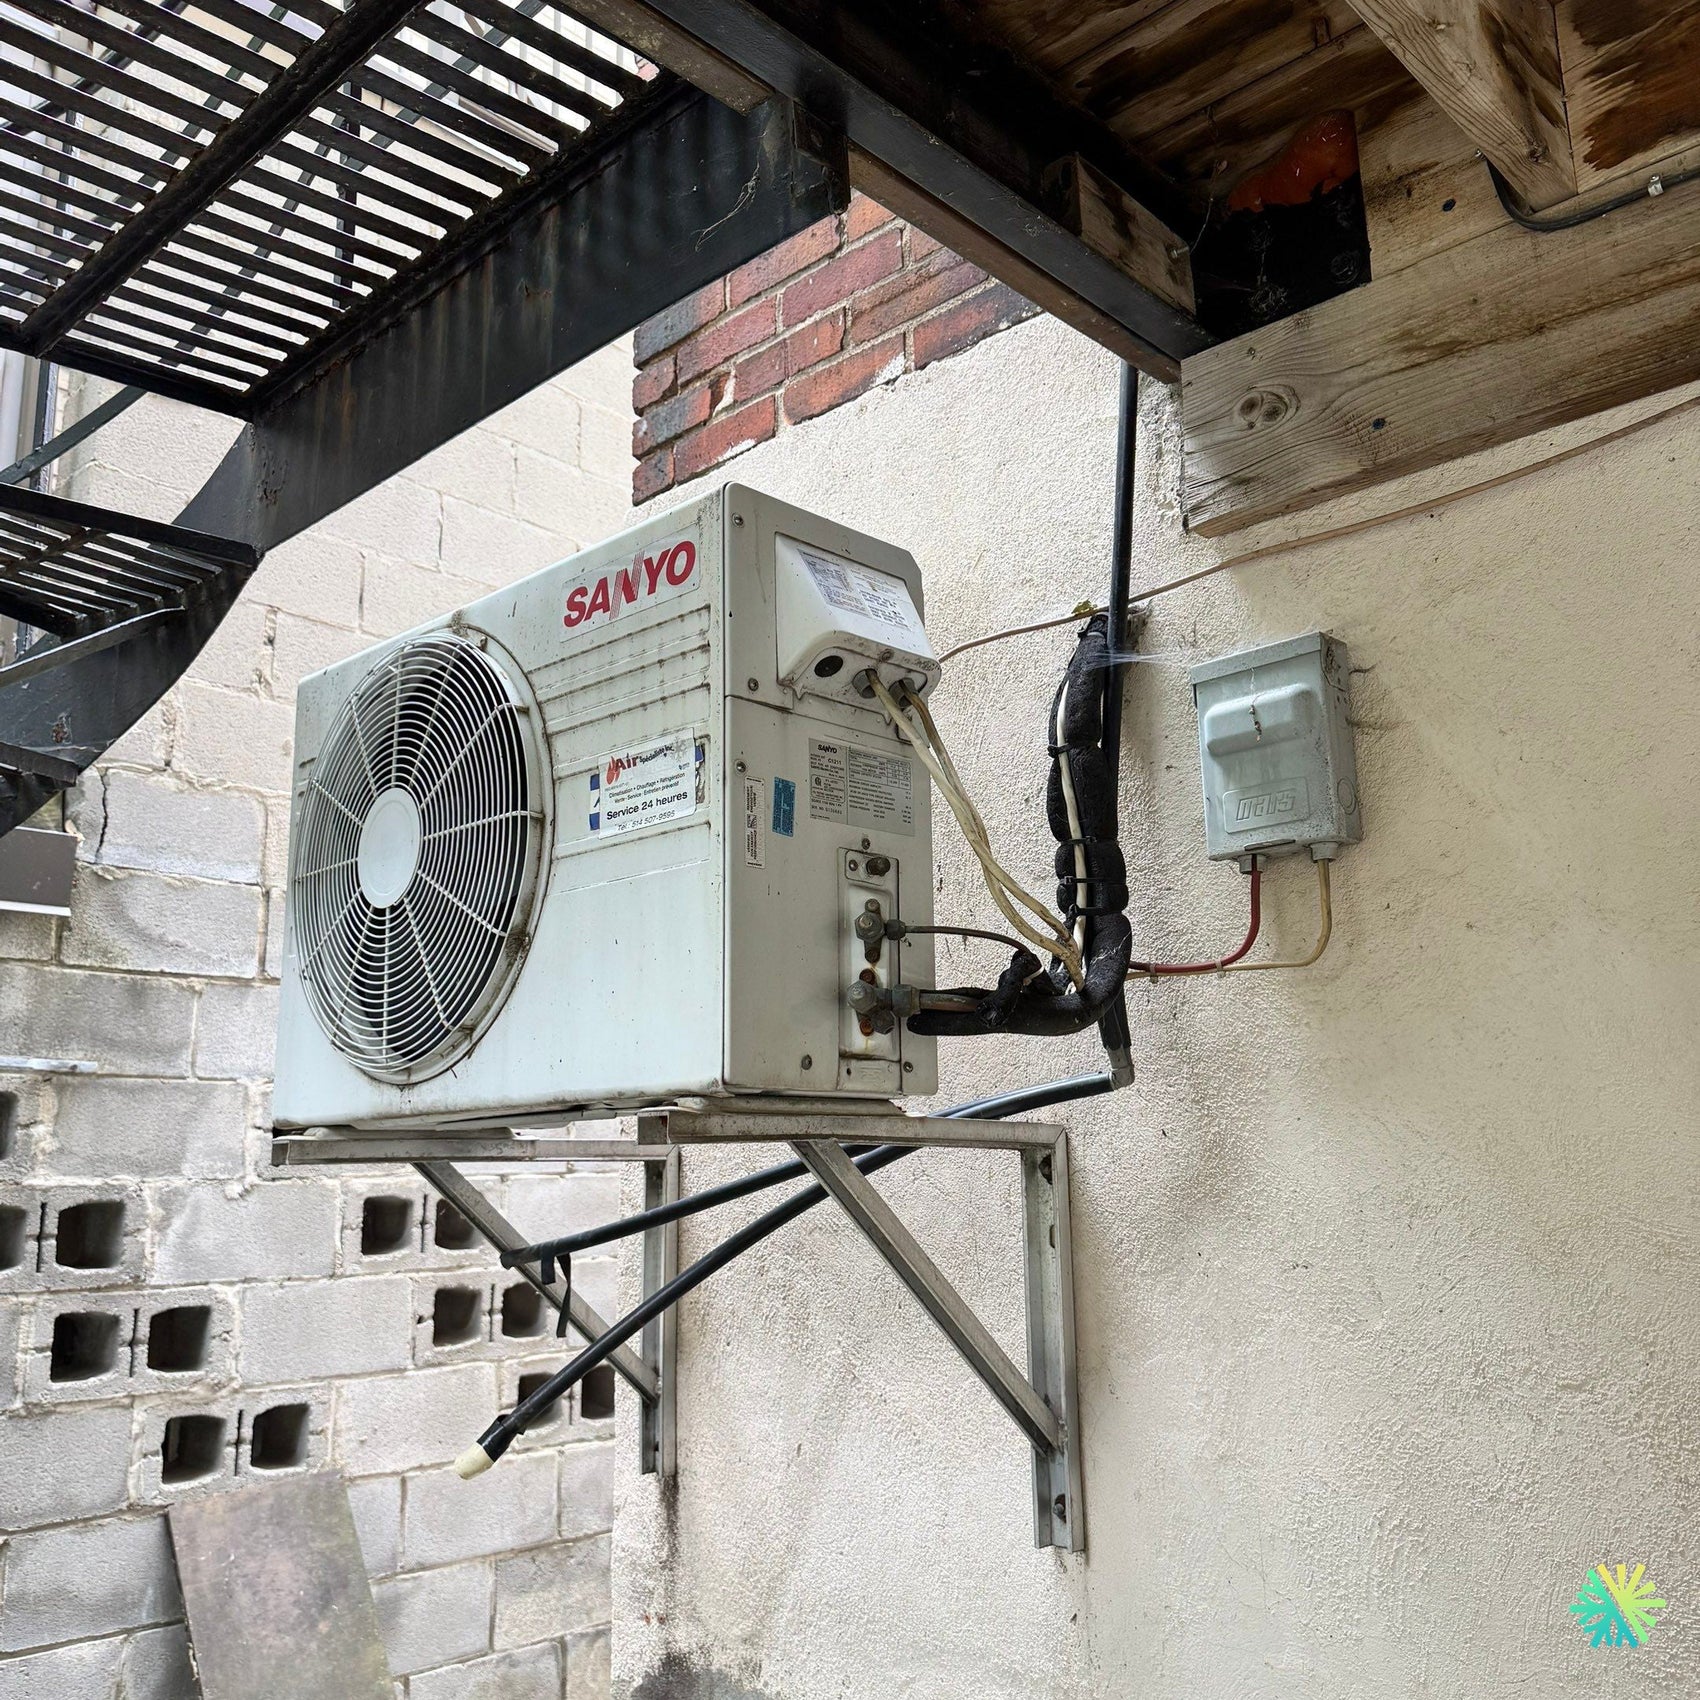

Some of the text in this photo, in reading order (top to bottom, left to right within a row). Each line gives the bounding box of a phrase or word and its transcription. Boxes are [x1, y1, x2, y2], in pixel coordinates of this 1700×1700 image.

[563, 540, 697, 628] SANYO
[818, 744, 837, 754] SANYO
[614, 752, 639, 771] Air
[637, 780, 657, 791] Chauffage
[606, 791, 688, 820] Service 24 heures
